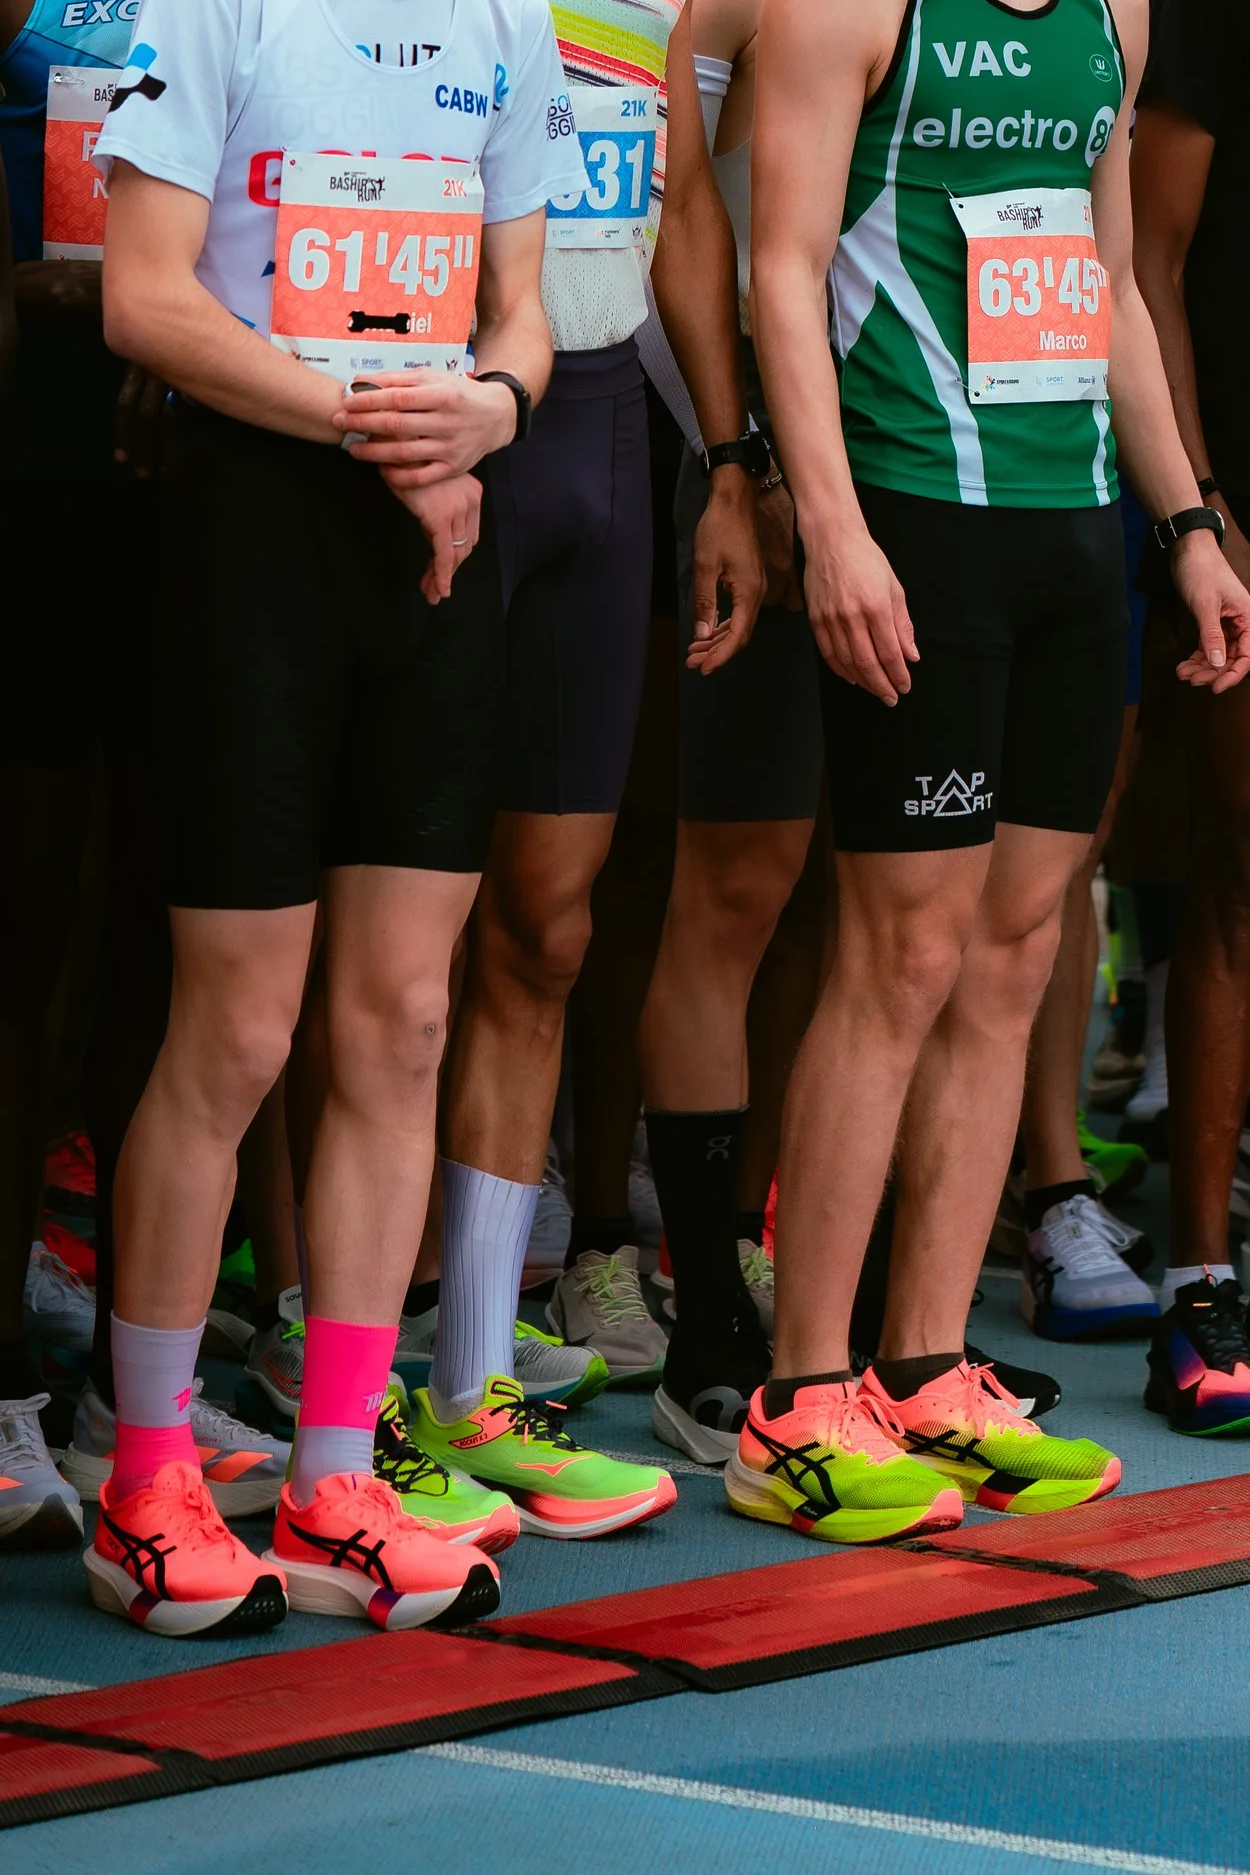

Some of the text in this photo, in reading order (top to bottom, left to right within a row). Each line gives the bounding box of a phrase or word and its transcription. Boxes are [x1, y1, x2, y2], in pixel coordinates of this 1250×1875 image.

[932, 40, 1032, 78] VAC
[435, 84, 488, 118] CABW
[621, 99, 648, 117] 21K
[913, 108, 1113, 153] electro 8
[443, 179, 467, 197] 21K
[550, 139, 645, 211] 31
[1039, 330, 1087, 351] Marco
